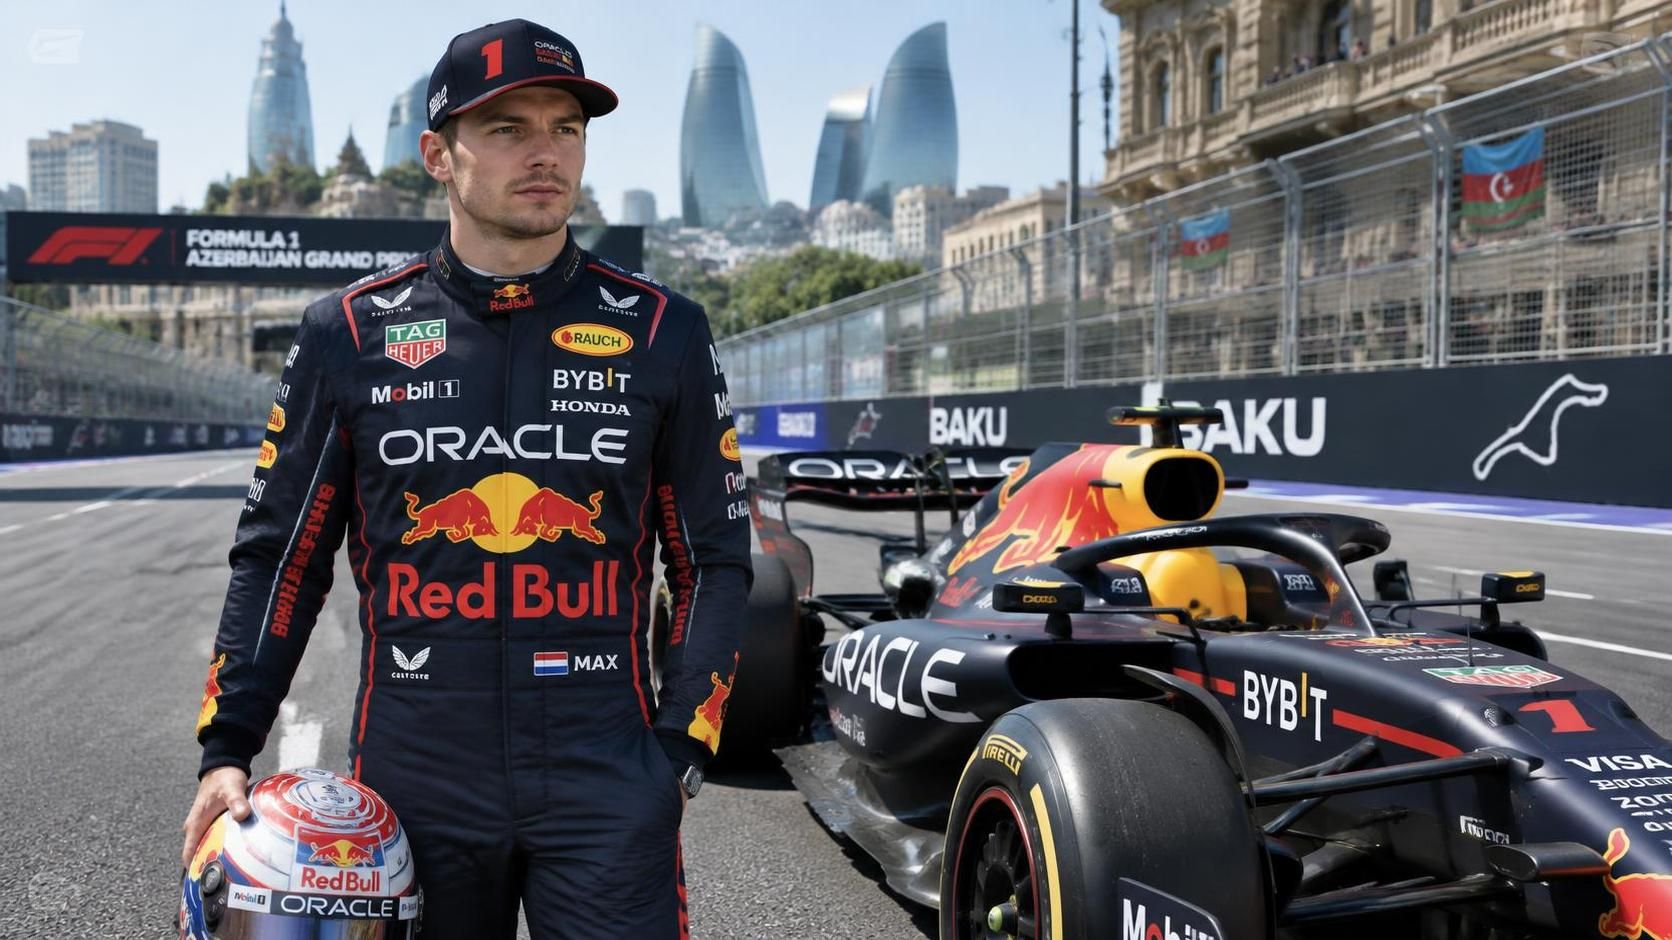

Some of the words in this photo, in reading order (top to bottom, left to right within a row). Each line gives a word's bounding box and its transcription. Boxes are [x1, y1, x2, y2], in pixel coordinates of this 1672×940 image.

[481, 38, 503, 80] 1
[186, 230, 286, 249] FORMULA
[288, 231, 299, 249] 1
[186, 250, 300, 267] AZERBAIJAN
[304, 251, 373, 268] GRAND
[390, 323, 441, 341] TAG
[573, 332, 622, 347] RAUCH
[388, 341, 442, 365] HEUER
[553, 368, 631, 393] BYBIT
[371, 381, 434, 405] Mobil
[550, 400, 632, 417] HONDA
[929, 406, 1008, 446] BAKU
[378, 424, 630, 466] ORACLE
[387, 562, 496, 619] Red
[512, 560, 619, 619] Bull
[574, 654, 619, 671] MAX
[1243, 669, 1328, 742] BYBIT
[1518, 700, 1596, 733] 1
[1564, 754, 1672, 772] VISA
[301, 867, 343, 892] Red
[345, 870, 380, 892] Bull
[281, 896, 393, 917] ORACLE
